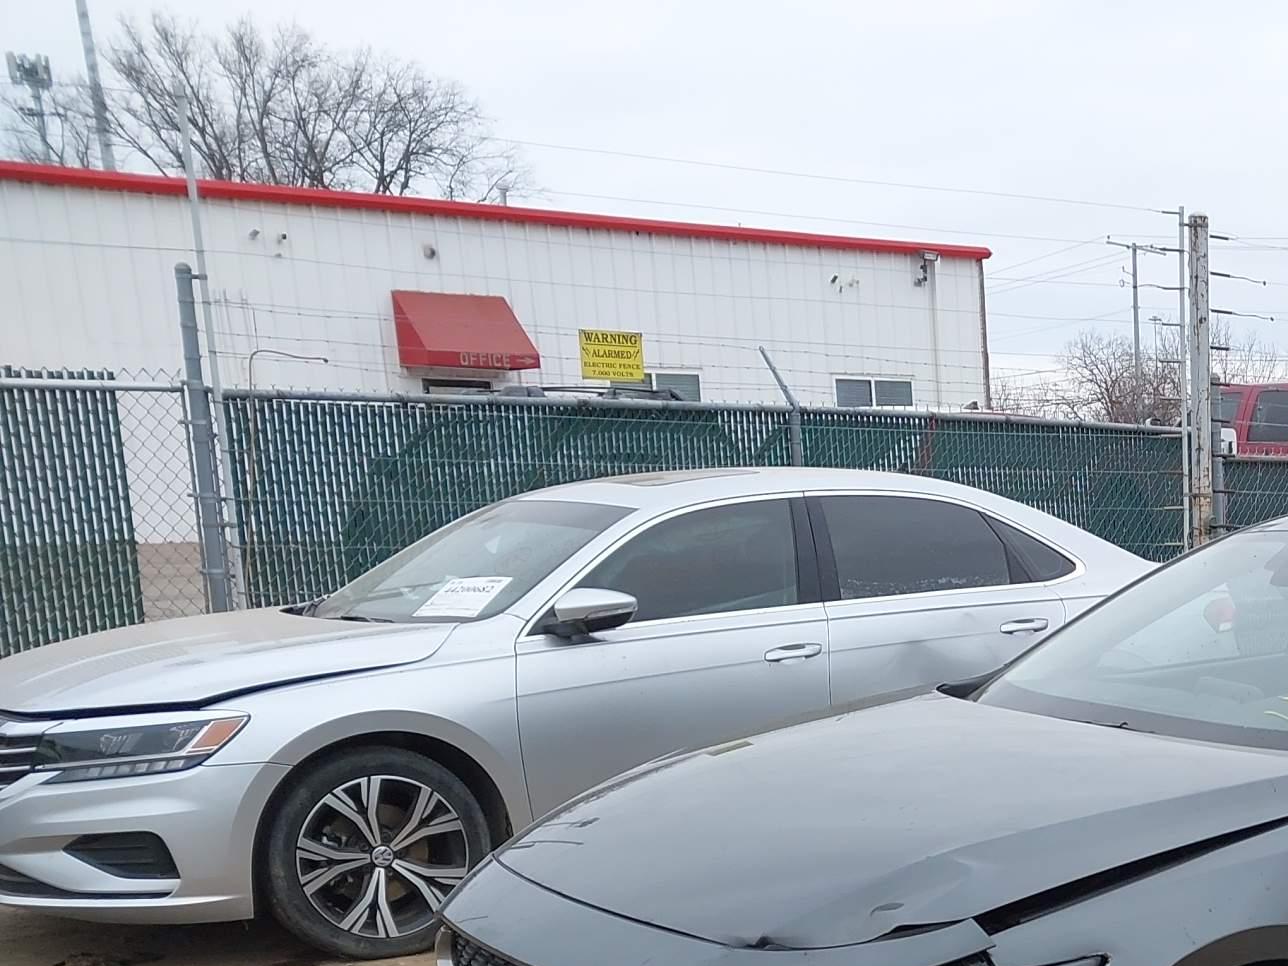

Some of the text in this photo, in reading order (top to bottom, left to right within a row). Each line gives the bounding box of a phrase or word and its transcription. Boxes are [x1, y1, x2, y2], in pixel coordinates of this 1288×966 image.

[583, 331, 637, 345] WARNING
[460, 352, 511, 369] OFFICE
[591, 348, 632, 360] ALARMED
[583, 361, 641, 370] ELECTRIC FENCE
